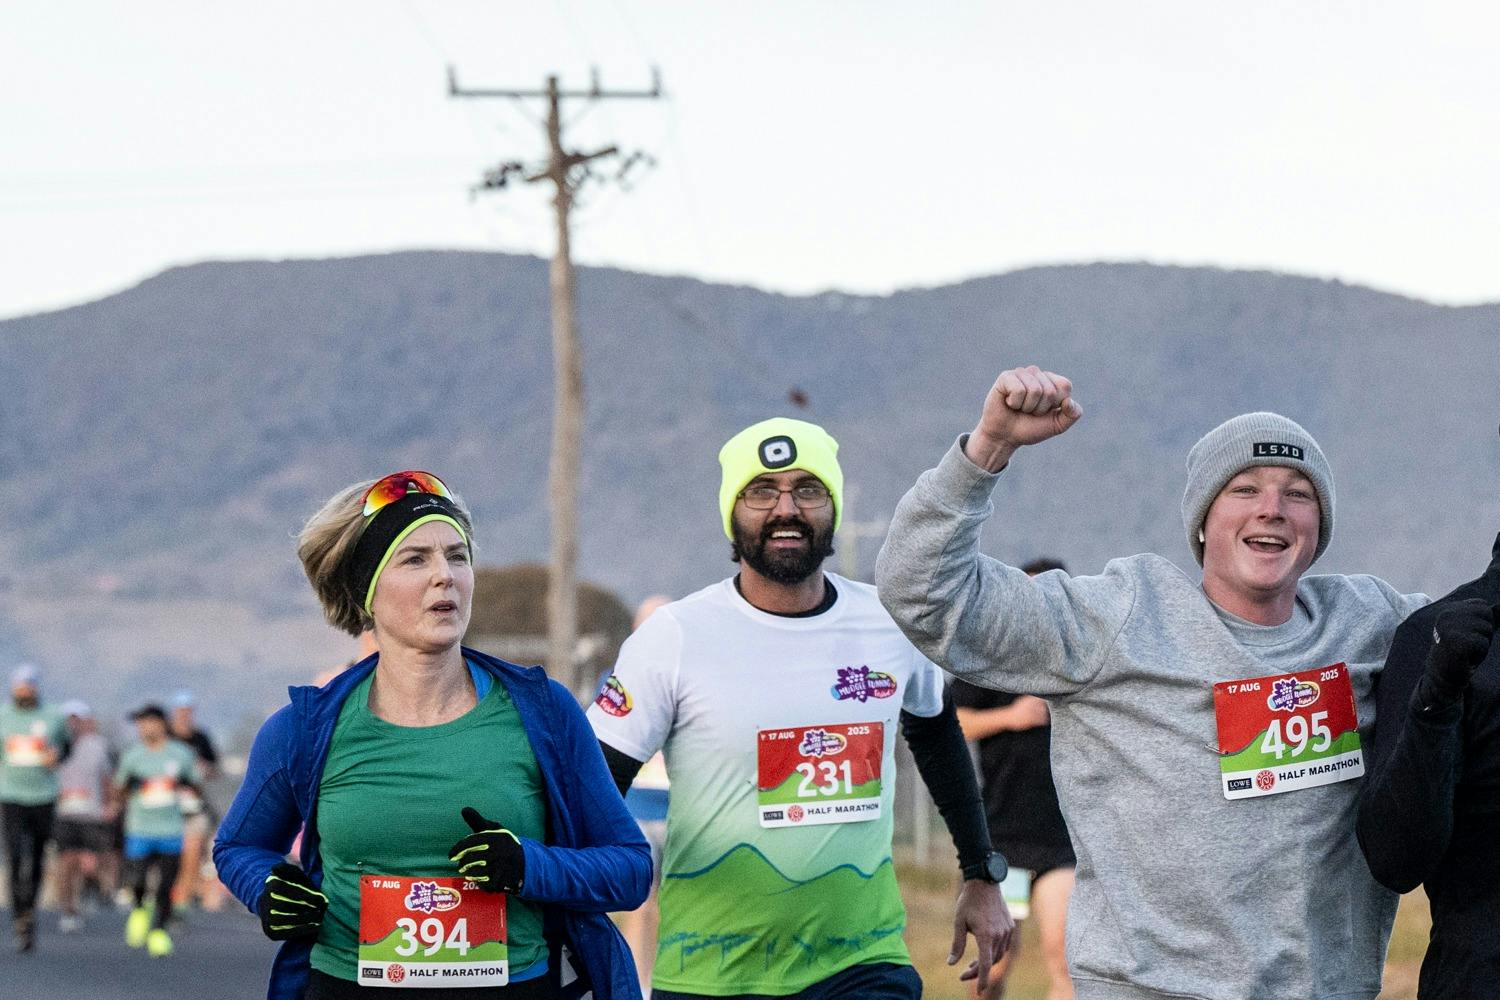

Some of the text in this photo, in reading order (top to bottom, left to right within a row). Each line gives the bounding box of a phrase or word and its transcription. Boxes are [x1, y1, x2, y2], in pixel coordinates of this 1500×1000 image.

[1258, 445, 1299, 457] LSKD
[1320, 669, 1339, 682] 2025
[1227, 683, 1261, 694] 17 AUG
[778, 732, 796, 740] AUG
[847, 726, 870, 736] 2025
[1260, 710, 1332, 760] 495
[1279, 769, 1306, 781] HALF
[1309, 757, 1360, 776] MARATHON
[796, 760, 853, 798] 231
[807, 807, 832, 816] HALF
[835, 802, 879, 813] MARATHON
[372, 880, 401, 889] 17 AUG
[394, 917, 471, 957] 394
[409, 968, 439, 977] HALF
[442, 967, 503, 977] MARATHON
